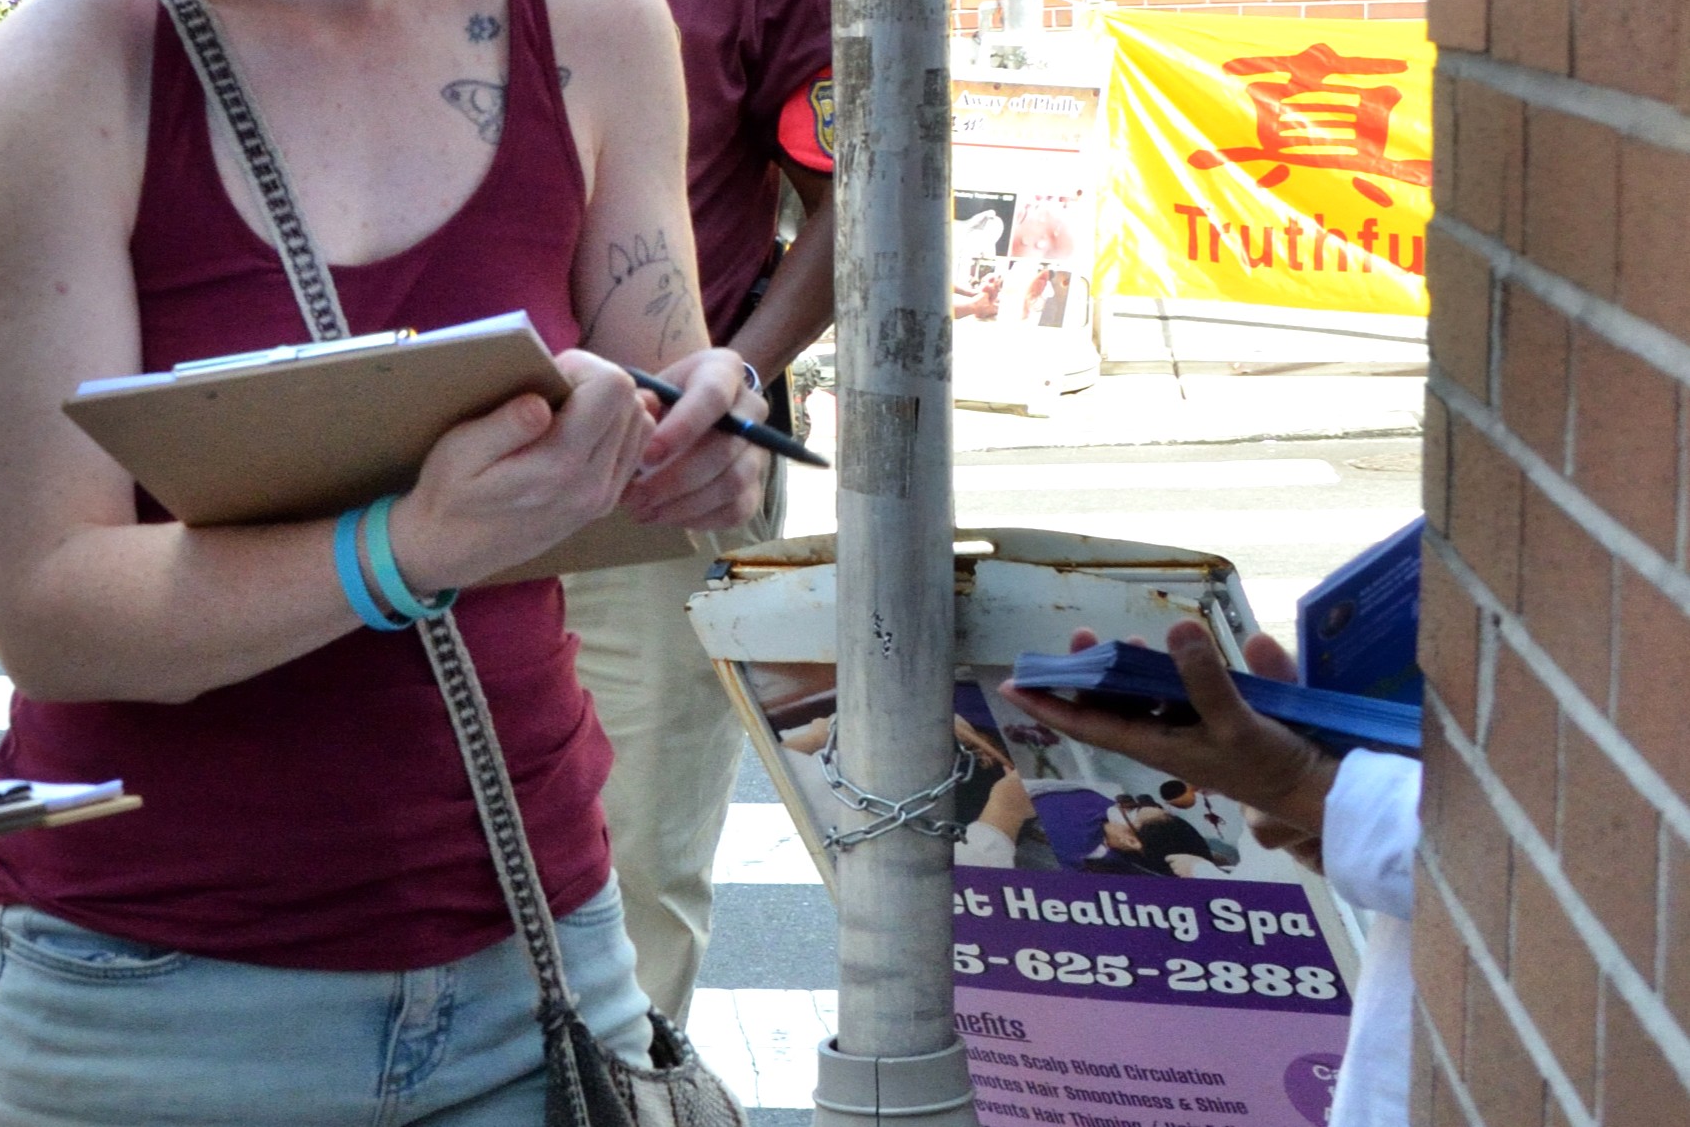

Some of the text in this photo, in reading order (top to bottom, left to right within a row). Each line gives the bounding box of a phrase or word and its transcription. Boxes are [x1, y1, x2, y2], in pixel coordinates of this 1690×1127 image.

[1187, 42, 1432, 207] 真
[1173, 203, 1425, 276] Truthfu
[1002, 886, 1198, 942] Healing
[1210, 898, 1316, 945] Spa
[954, 943, 1338, 1000] 5-625-2888
[1020, 1053, 1069, 1075] Scalp
[1071, 1059, 1121, 1079] Blood
[1124, 1064, 1227, 1087] Circulation
[1026, 1080, 1060, 1099] Hair
[1064, 1085, 1175, 1111] Smoothness
[1179, 1098, 1194, 1112] &
[1197, 1096, 1250, 1116] Shine
[1032, 1107, 1066, 1126] Hair
